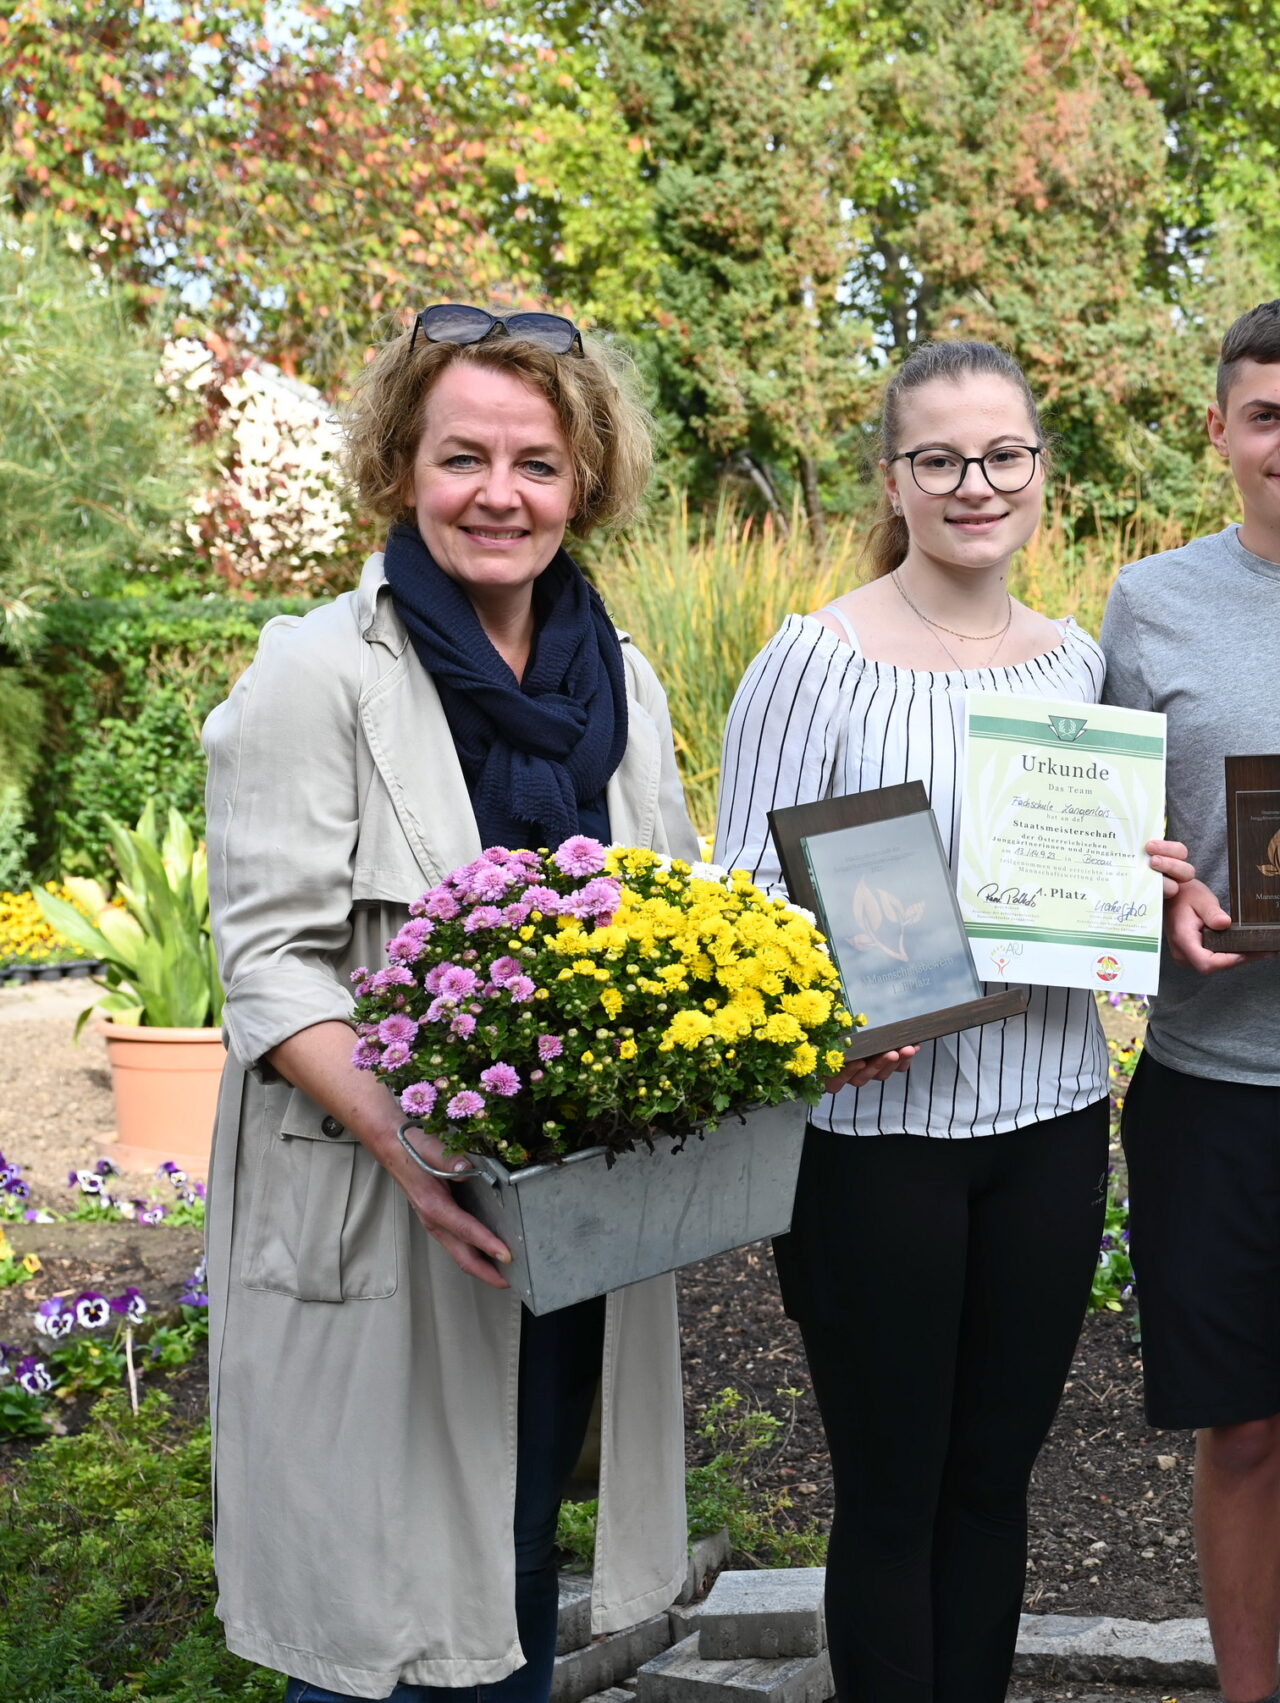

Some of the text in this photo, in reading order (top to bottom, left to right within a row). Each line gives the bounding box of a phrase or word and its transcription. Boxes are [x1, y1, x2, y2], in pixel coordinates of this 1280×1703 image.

[1022, 754, 1109, 780] Urkunde
[1048, 783, 1093, 795] Das Team
[1013, 820, 1116, 839] Staatsmeisterschaft
[1021, 833, 1035, 841] der
[1051, 888, 1087, 900] Platz
